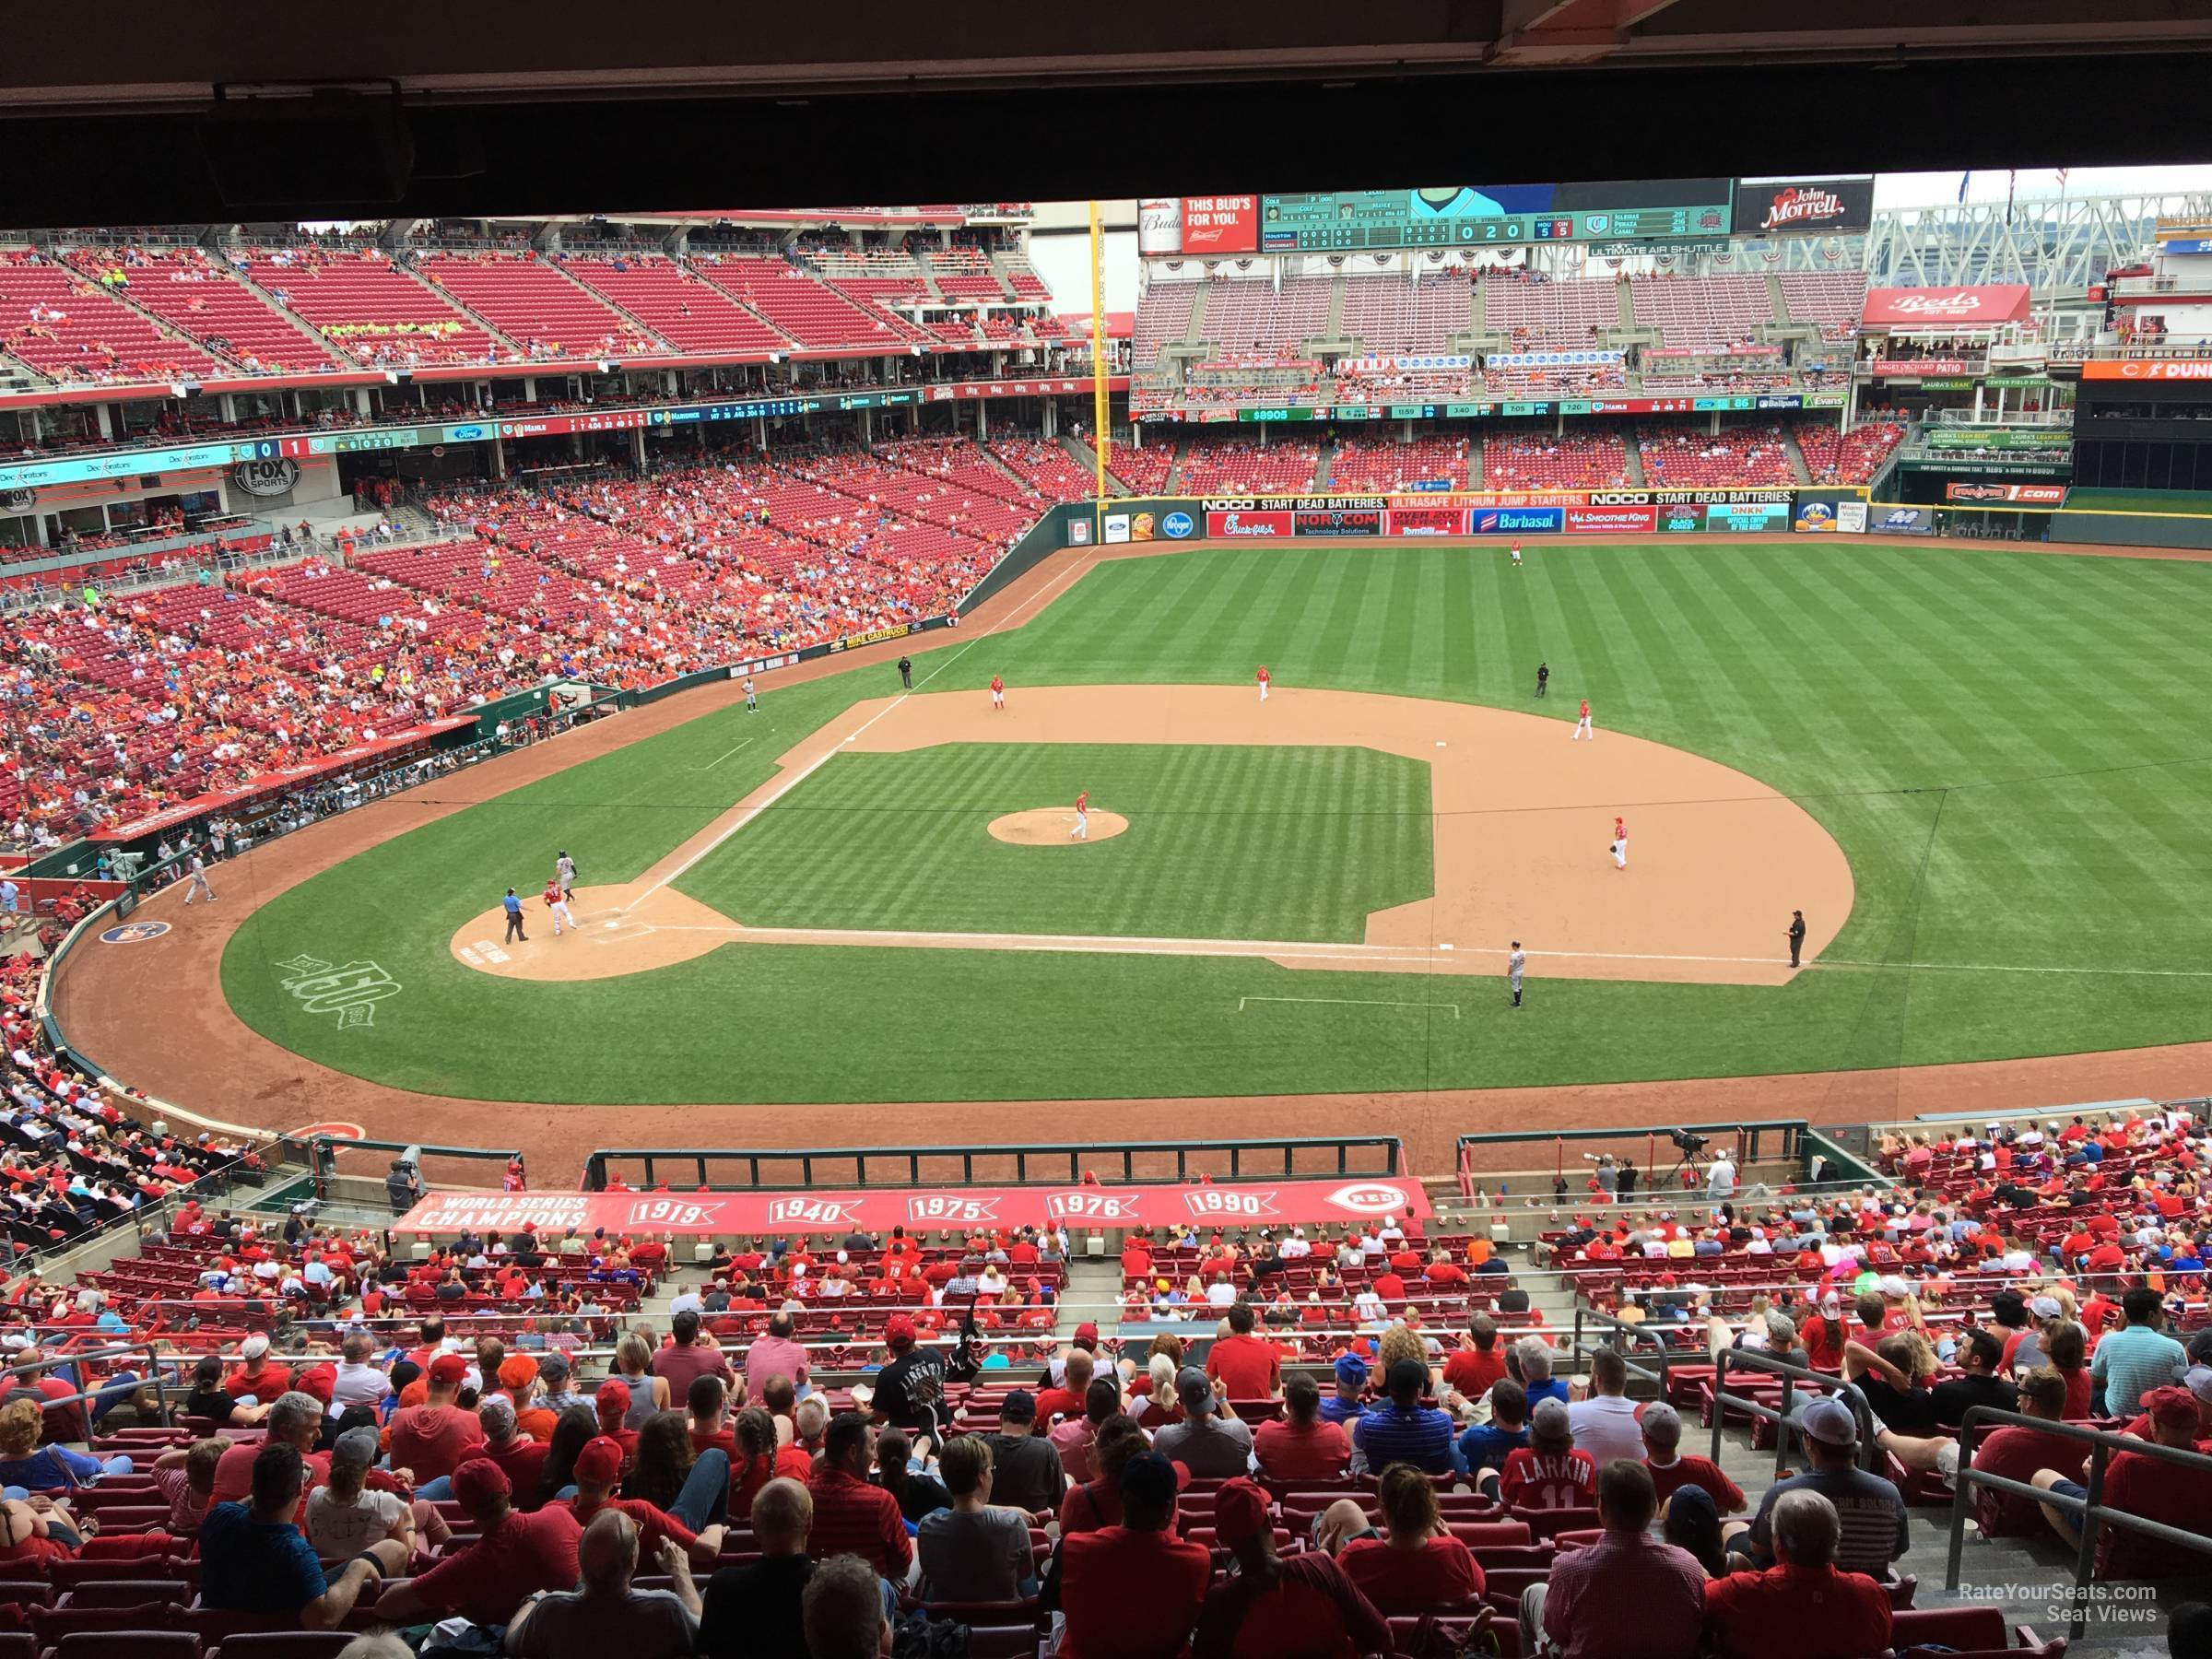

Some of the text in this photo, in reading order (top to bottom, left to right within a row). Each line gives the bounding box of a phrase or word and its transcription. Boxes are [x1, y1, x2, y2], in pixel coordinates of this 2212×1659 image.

[1187, 197, 1251, 211] THIS BUD'S
[1793, 188, 1824, 204] John
[1187, 212, 1239, 227] FOR YOU.
[1760, 194, 1845, 229] Morrell
[1462, 225, 1519, 240] 0 2 0
[1559, 227, 1567, 236] 5
[1592, 243, 1724, 256] ULTIMATE AIR SHUTTLE
[1888, 292, 1981, 312] Reds
[1936, 363, 1961, 373] PATIO
[1735, 398, 1748, 407] 86
[1769, 398, 1800, 409] Ballpark
[1814, 397, 1843, 406] Evans
[1253, 410, 1288, 420] $8905
[260, 444, 271, 457] 0
[290, 441, 299, 453] 1
[250, 461, 286, 480] FOX
[251, 477, 288, 488] SPORTS
[1202, 490, 1794, 511] NOCO START DEAD BATTERIES. ULTRASAFE LITHIUM JUMP STARTERS. NOCO START DEAD BATTERIES.
[1394, 511, 1429, 519] OVER
[1587, 513, 1650, 522] SMOOTHIE KING
[1166, 517, 1190, 534] Kroger
[847, 635, 866, 646] MIKE
[867, 626, 909, 641] CASTRUCCI
[441, 1197, 589, 1210] WORLD SERIES
[1052, 1195, 1120, 1217] 1976
[1192, 1194, 1260, 1214] 1990
[1348, 1193, 1406, 1204] REDS
[637, 1201, 703, 1224] 1919
[775, 1199, 841, 1222] 1940
[914, 1198, 982, 1218] 1975
[419, 1211, 587, 1227] CHAMPIONS
[889, 1266, 900, 1277] 19
[900, 1362, 941, 1390] LIBERTY
[1519, 1456, 1591, 1487] LARKIN
[1542, 1485, 1574, 1508] 11
